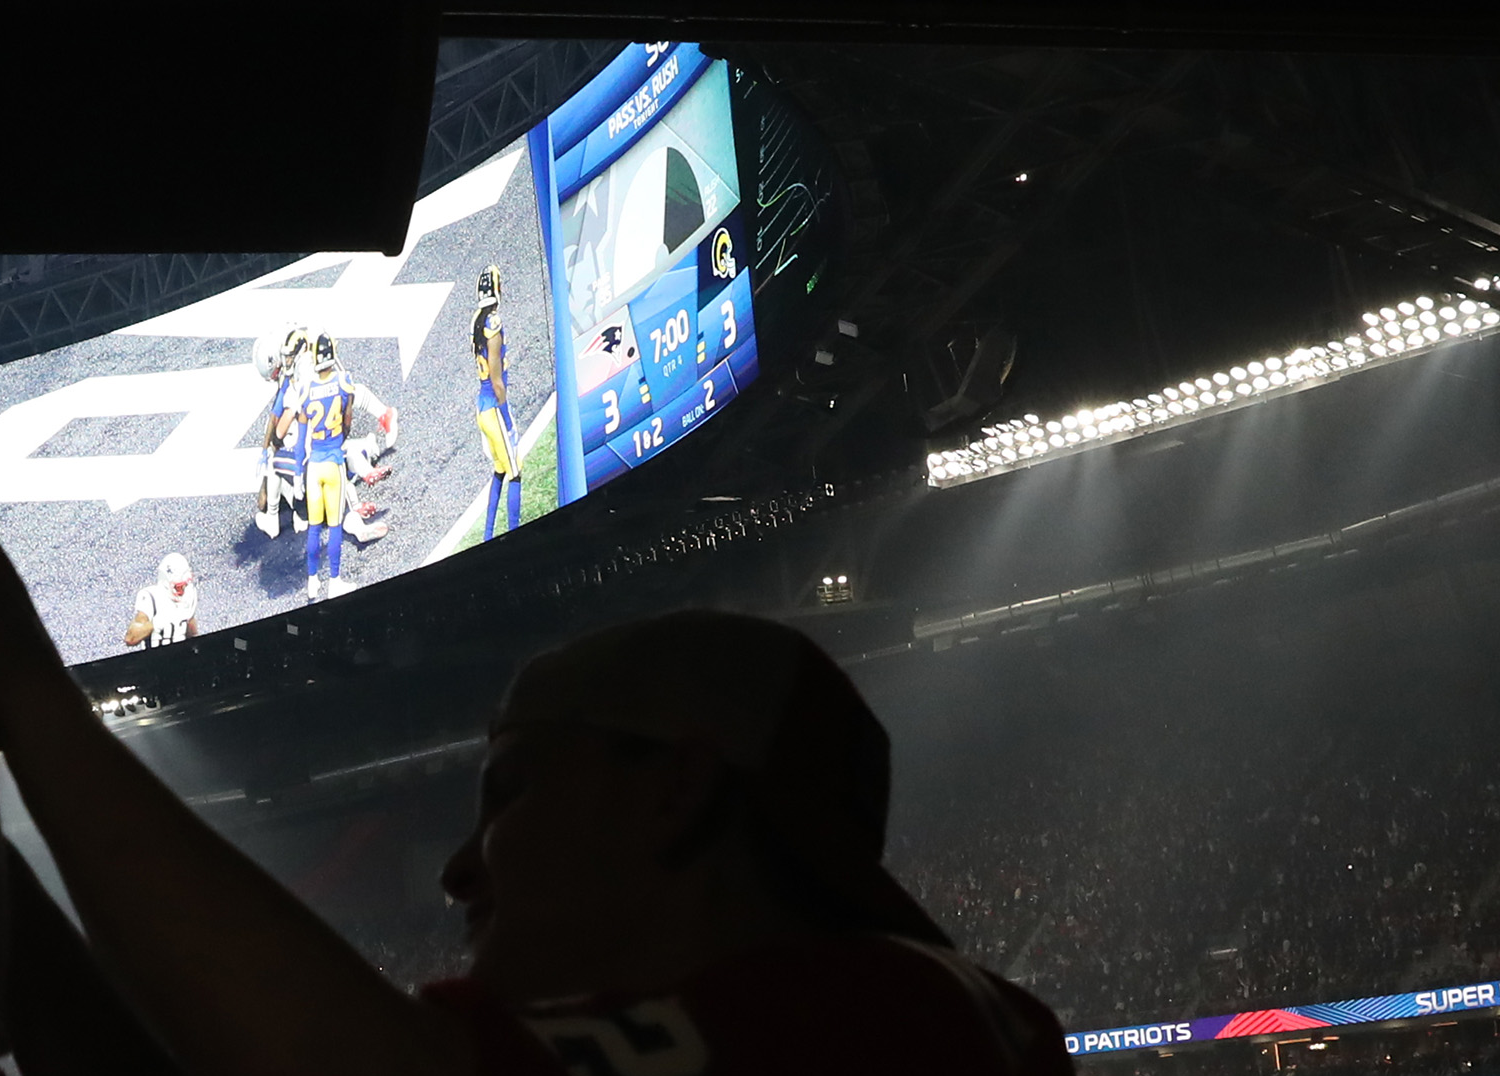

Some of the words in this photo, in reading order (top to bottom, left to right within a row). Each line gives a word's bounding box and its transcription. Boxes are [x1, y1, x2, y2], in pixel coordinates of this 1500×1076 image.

[608, 101, 637, 139] PASS
[634, 85, 653, 113] VS.
[651, 54, 680, 98] RUSH
[649, 308, 691, 364] 7:00
[720, 299, 738, 350] 3
[663, 360, 676, 378] QTR
[306, 394, 345, 442] 24
[601, 389, 621, 435] 3
[703, 379, 717, 411] 2
[1084, 1022, 1192, 1051] PATRIOTS
[1415, 983, 1495, 1015] SUPER
